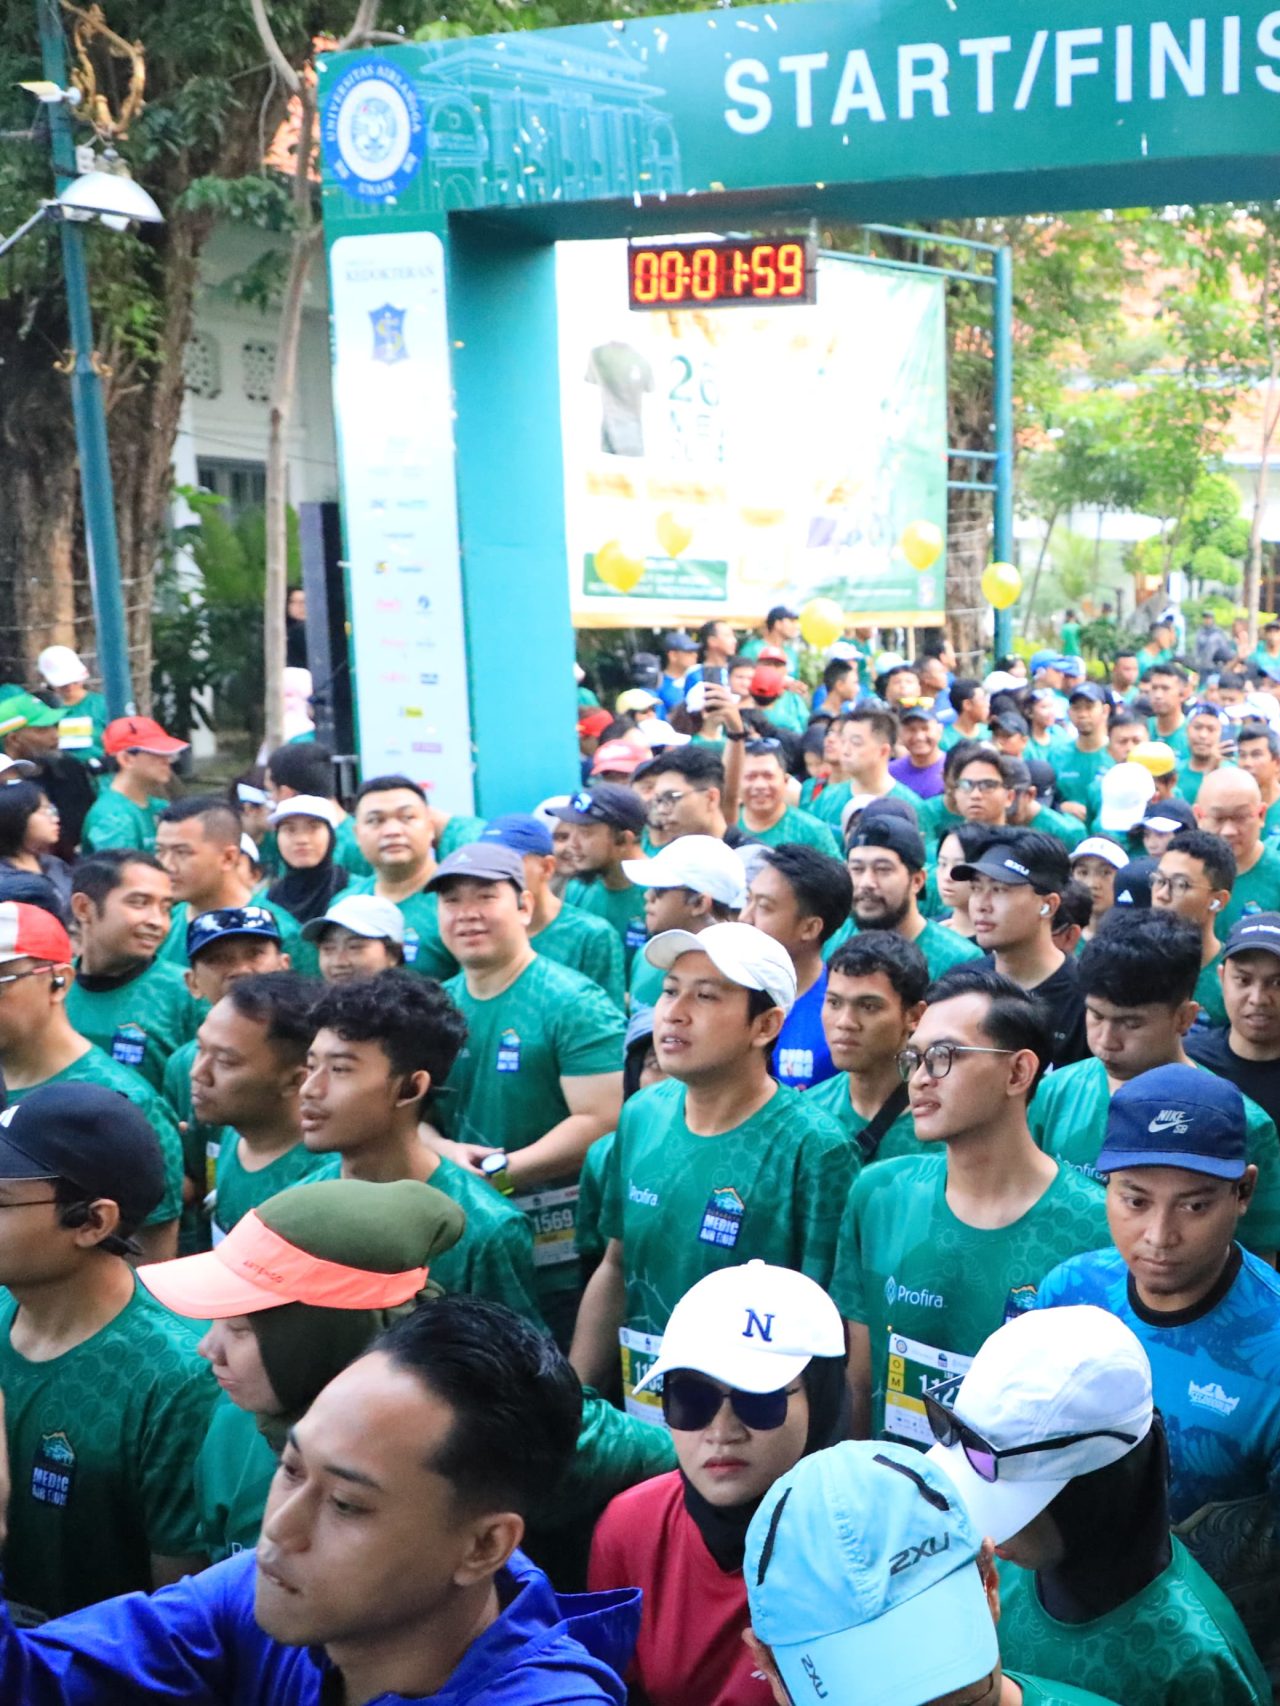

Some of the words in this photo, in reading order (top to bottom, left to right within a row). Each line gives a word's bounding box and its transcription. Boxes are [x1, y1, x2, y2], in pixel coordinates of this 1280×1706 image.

[633, 243, 803, 302] 00:01:59
[1156, 1110, 1187, 1122] NIKE
[702, 1214, 740, 1235] MEDIC
[898, 1285, 944, 1308] Profira
[741, 1308, 776, 1343] N
[32, 1466, 70, 1493] MEDIC
[888, 1532, 951, 1578] 2XU
[801, 1653, 828, 1700] 2XU
